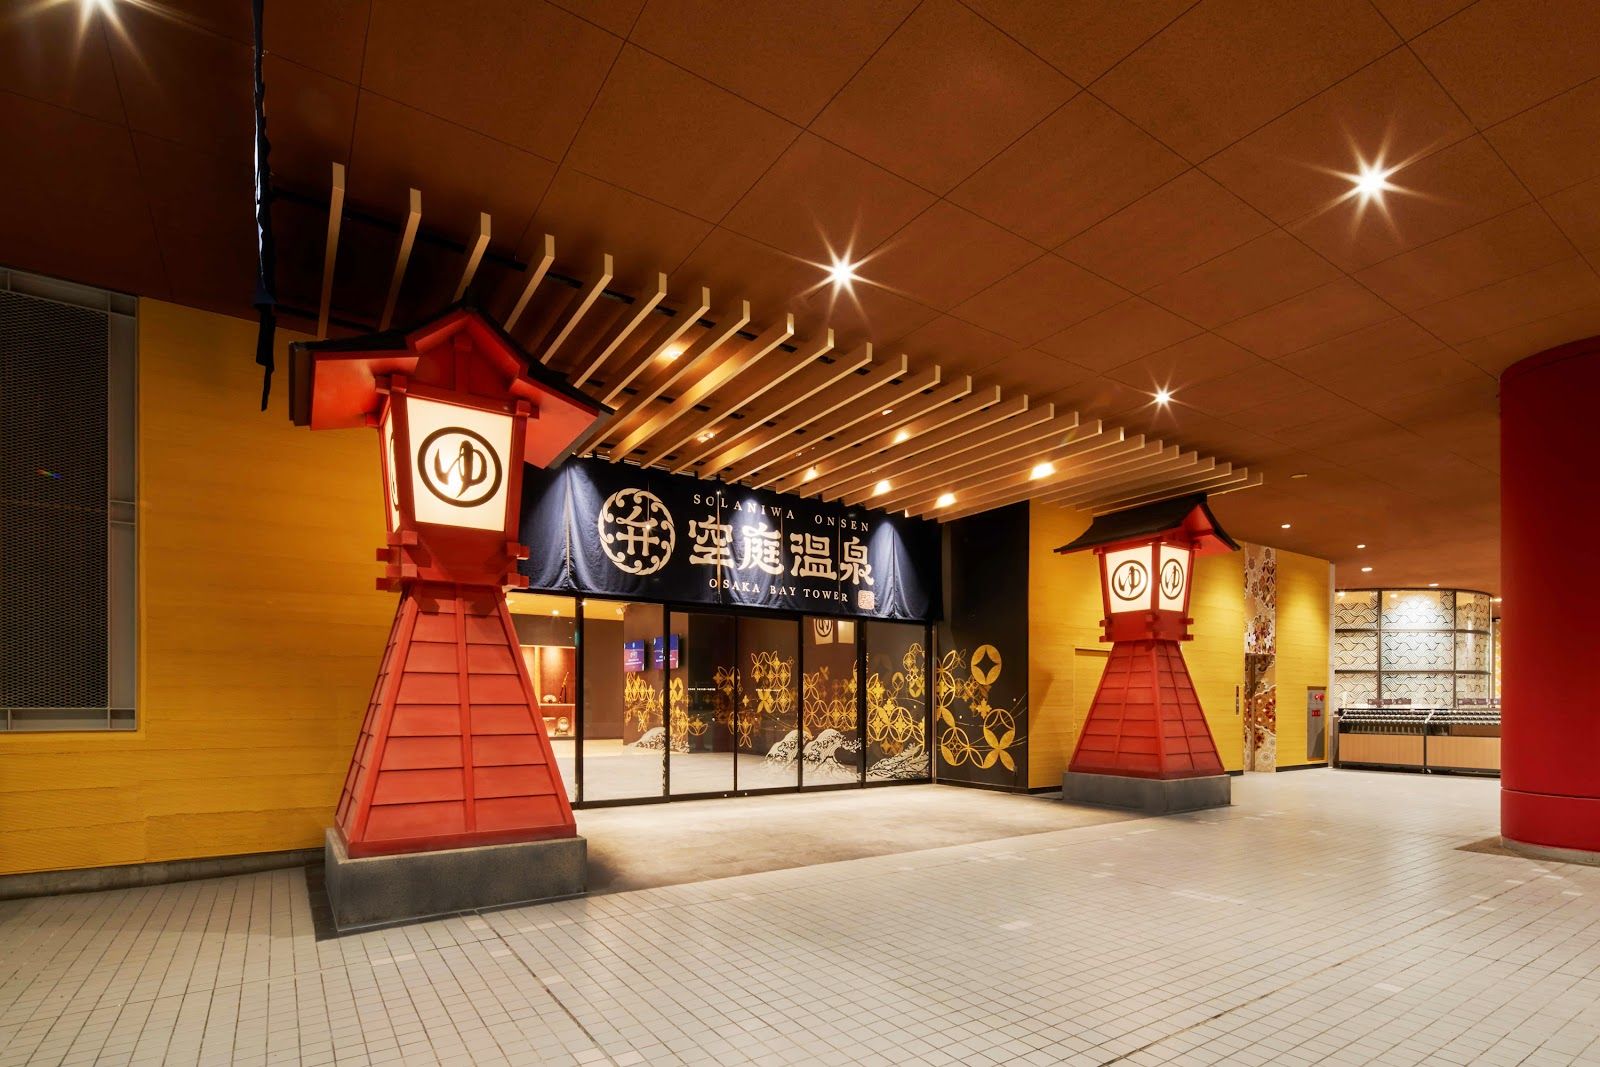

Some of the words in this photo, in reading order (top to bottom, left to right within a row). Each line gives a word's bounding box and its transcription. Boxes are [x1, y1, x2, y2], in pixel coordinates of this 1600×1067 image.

[434, 440, 487, 498] ゆ
[693, 494, 795, 520] SOLANIWA
[815, 514, 869, 532] ONSEN
[688, 515, 875, 586] 空庭温泉
[708, 578, 761, 594] OSAKA
[770, 585, 797, 596] BAY
[803, 588, 849, 602] TOWER
[1118, 565, 1142, 596] ゆ
